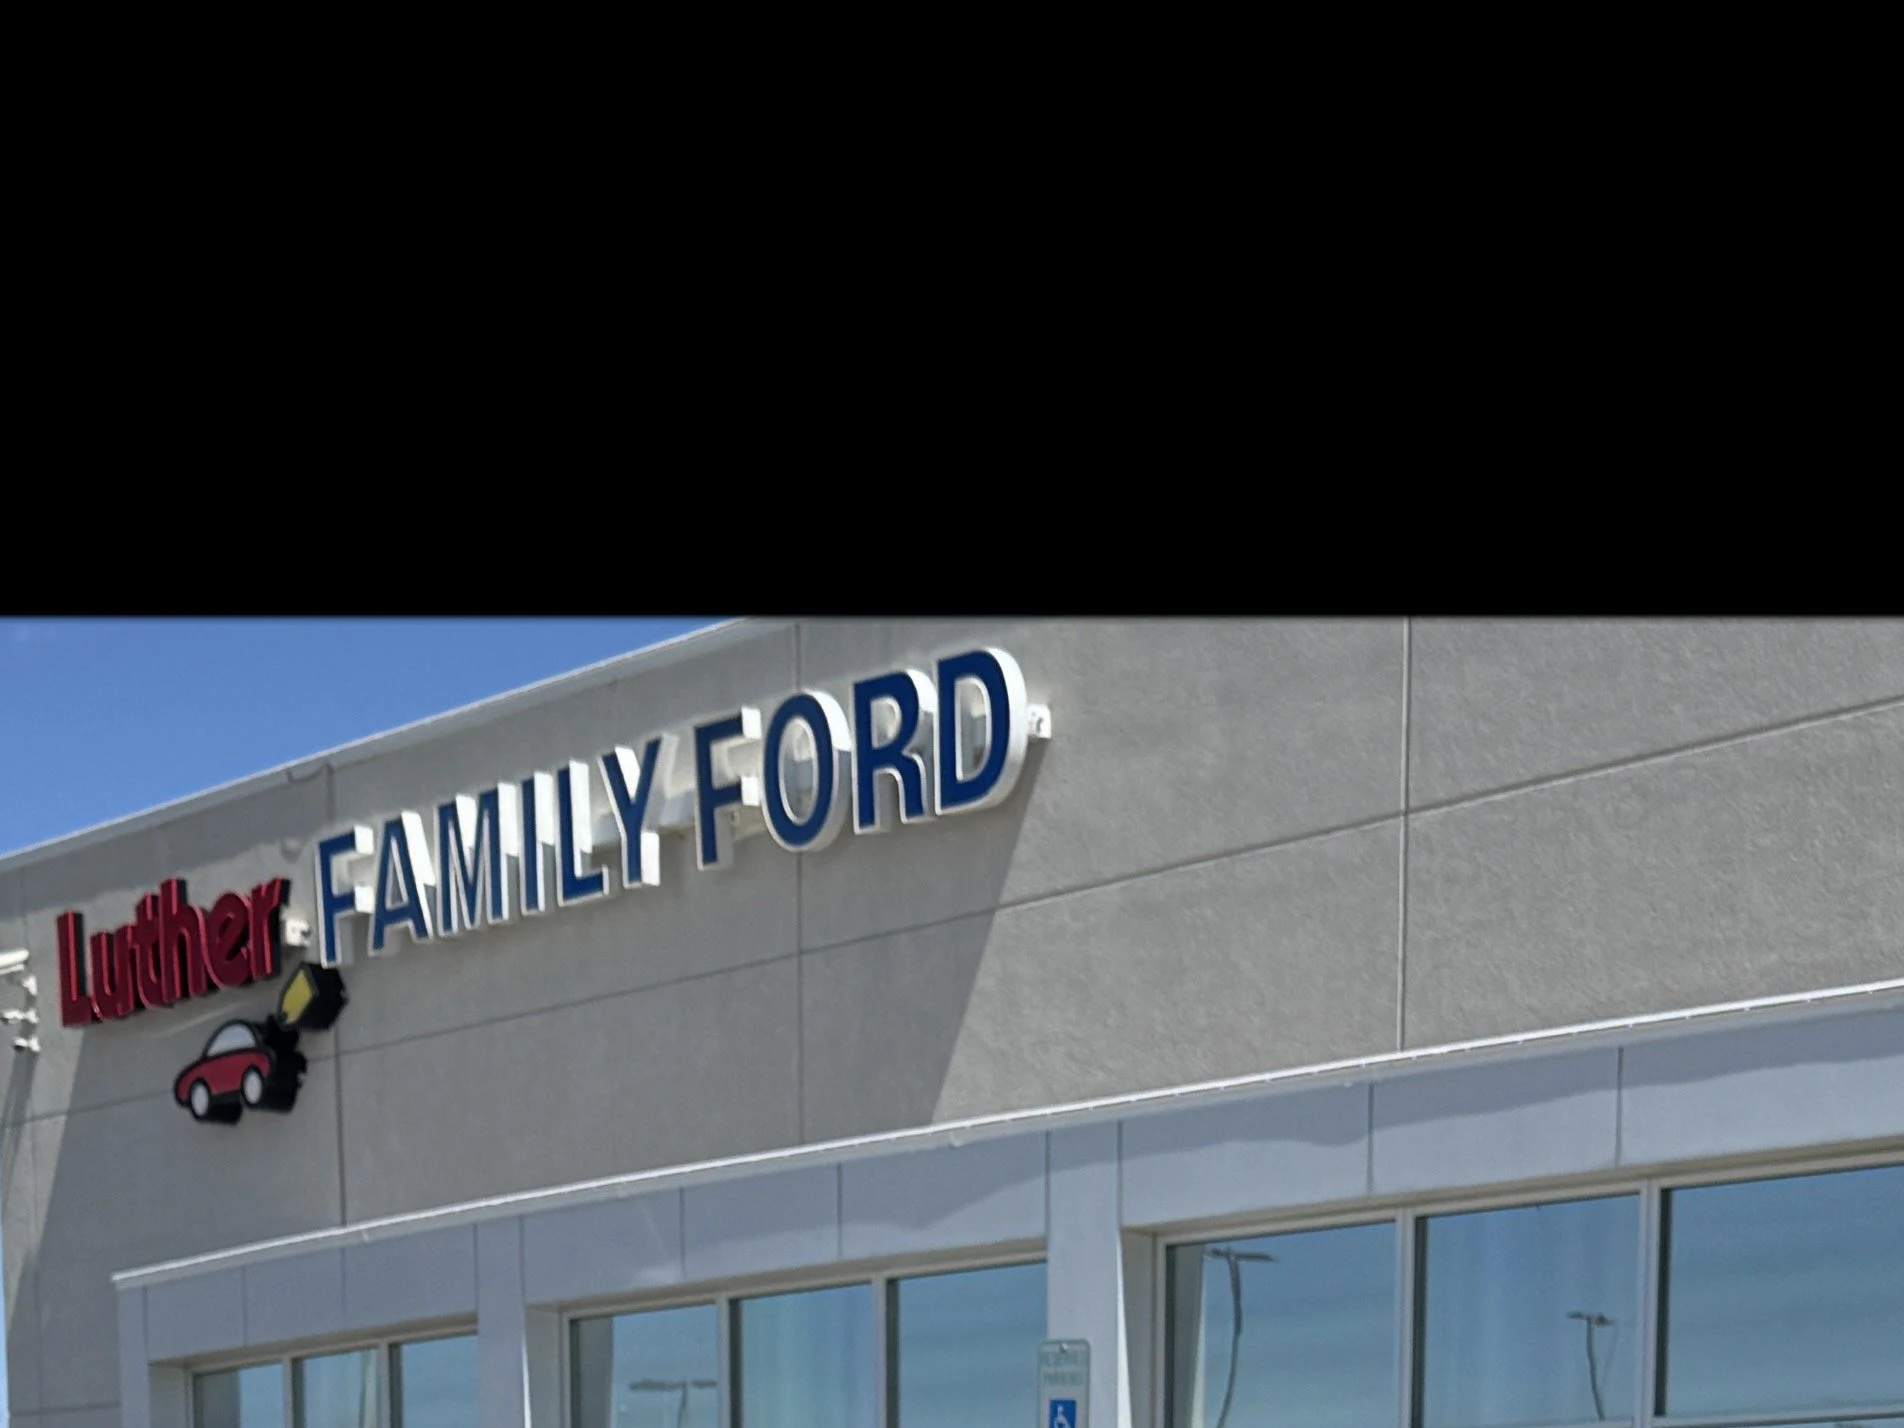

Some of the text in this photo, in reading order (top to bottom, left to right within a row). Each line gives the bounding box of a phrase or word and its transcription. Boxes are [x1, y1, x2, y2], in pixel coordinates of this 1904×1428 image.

[312, 645, 1027, 968] FAMILY FORD
[55, 876, 292, 1028] Luther
